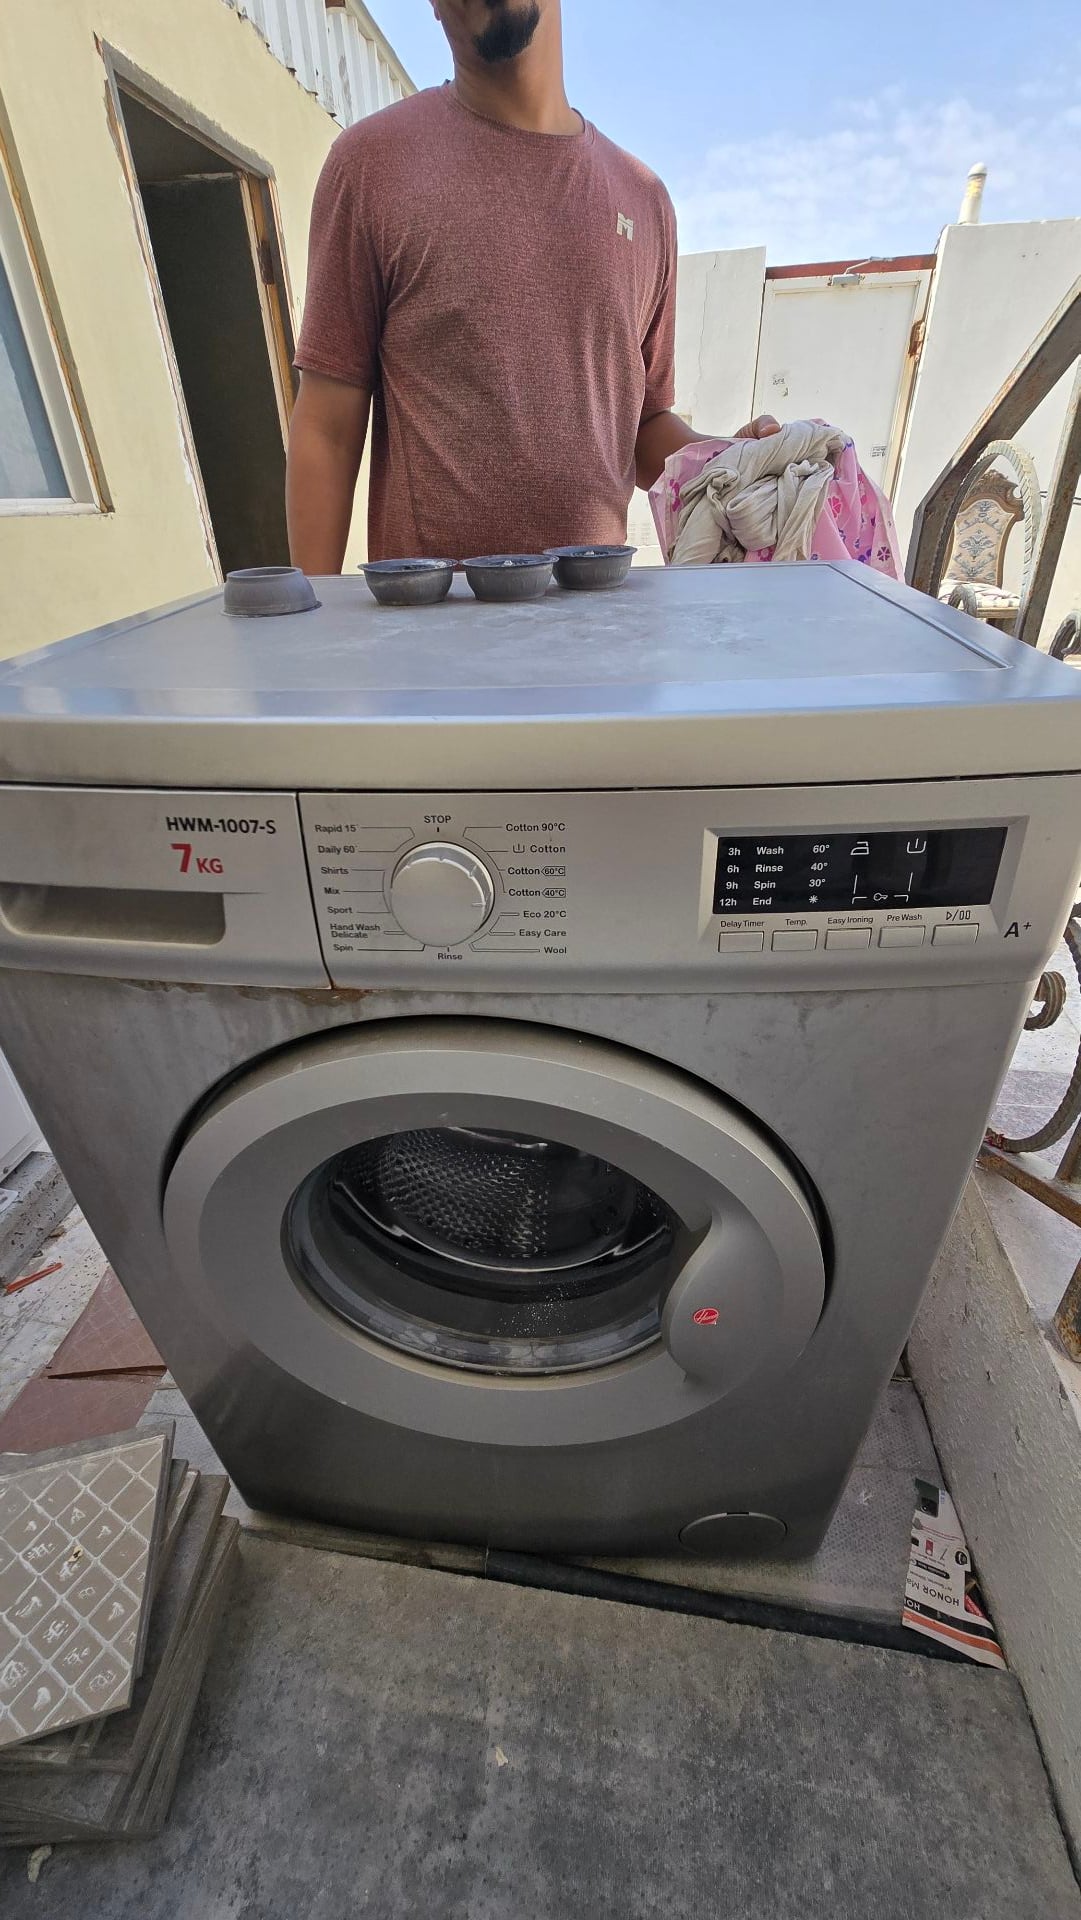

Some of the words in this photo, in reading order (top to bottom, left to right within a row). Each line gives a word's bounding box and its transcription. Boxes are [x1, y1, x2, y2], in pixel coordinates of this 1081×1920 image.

[424, 815, 451, 823] STOP
[166, 817, 276, 834] HWM-1007-S
[315, 825, 341, 833] Rapid
[506, 823, 538, 832] Cotton
[542, 823, 566, 831] 90°C
[318, 845, 341, 855] Daily
[757, 846, 784, 855] Wash
[813, 844, 829, 853] 60°
[171, 843, 191, 873] 7
[196, 857, 223, 873] KG
[508, 867, 540, 875] Cotton
[544, 867, 565, 875] 60°C
[727, 865, 739, 873] 6h
[755, 864, 783, 872] Rinse
[811, 862, 827, 871] 40°
[726, 882, 738, 890] 9h
[754, 880, 776, 890] Spin
[809, 879, 825, 887] 30°
[509, 888, 541, 896] Cotton
[544, 889, 565, 897] 40°C
[720, 898, 736, 906] 12h
[753, 897, 772, 905] End
[327, 906, 352, 915] Sport
[544, 910, 566, 918] 20°C
[720, 920, 742, 929] Delay
[743, 919, 764, 927] Timer
[827, 917, 846, 925] Easy
[847, 916, 874, 924] Ironing
[519, 929, 541, 938] Easy
[333, 944, 353, 952] Spin
[922, 1585, 959, 1606] HONOR
